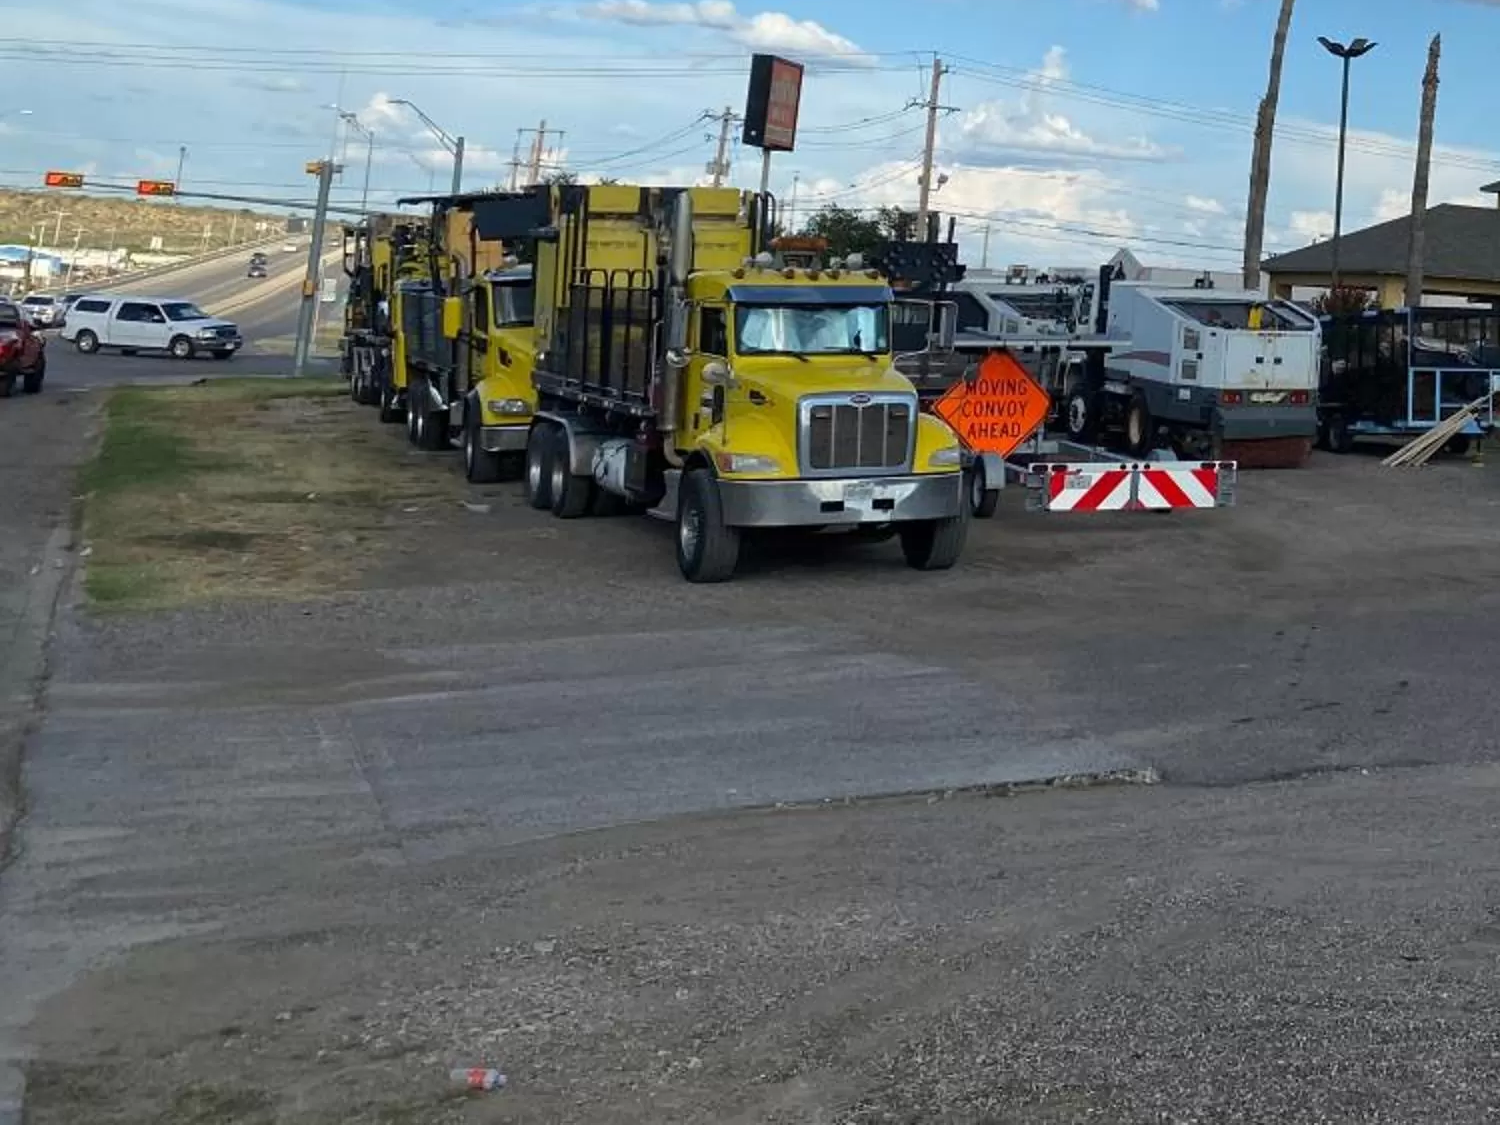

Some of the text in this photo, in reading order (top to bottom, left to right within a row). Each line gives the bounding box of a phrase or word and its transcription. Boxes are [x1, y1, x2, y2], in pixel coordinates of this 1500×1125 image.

[965, 378, 1028, 396] MOVING
[962, 399, 1028, 418] CONVOY
[967, 422, 1021, 440] AHEAD
